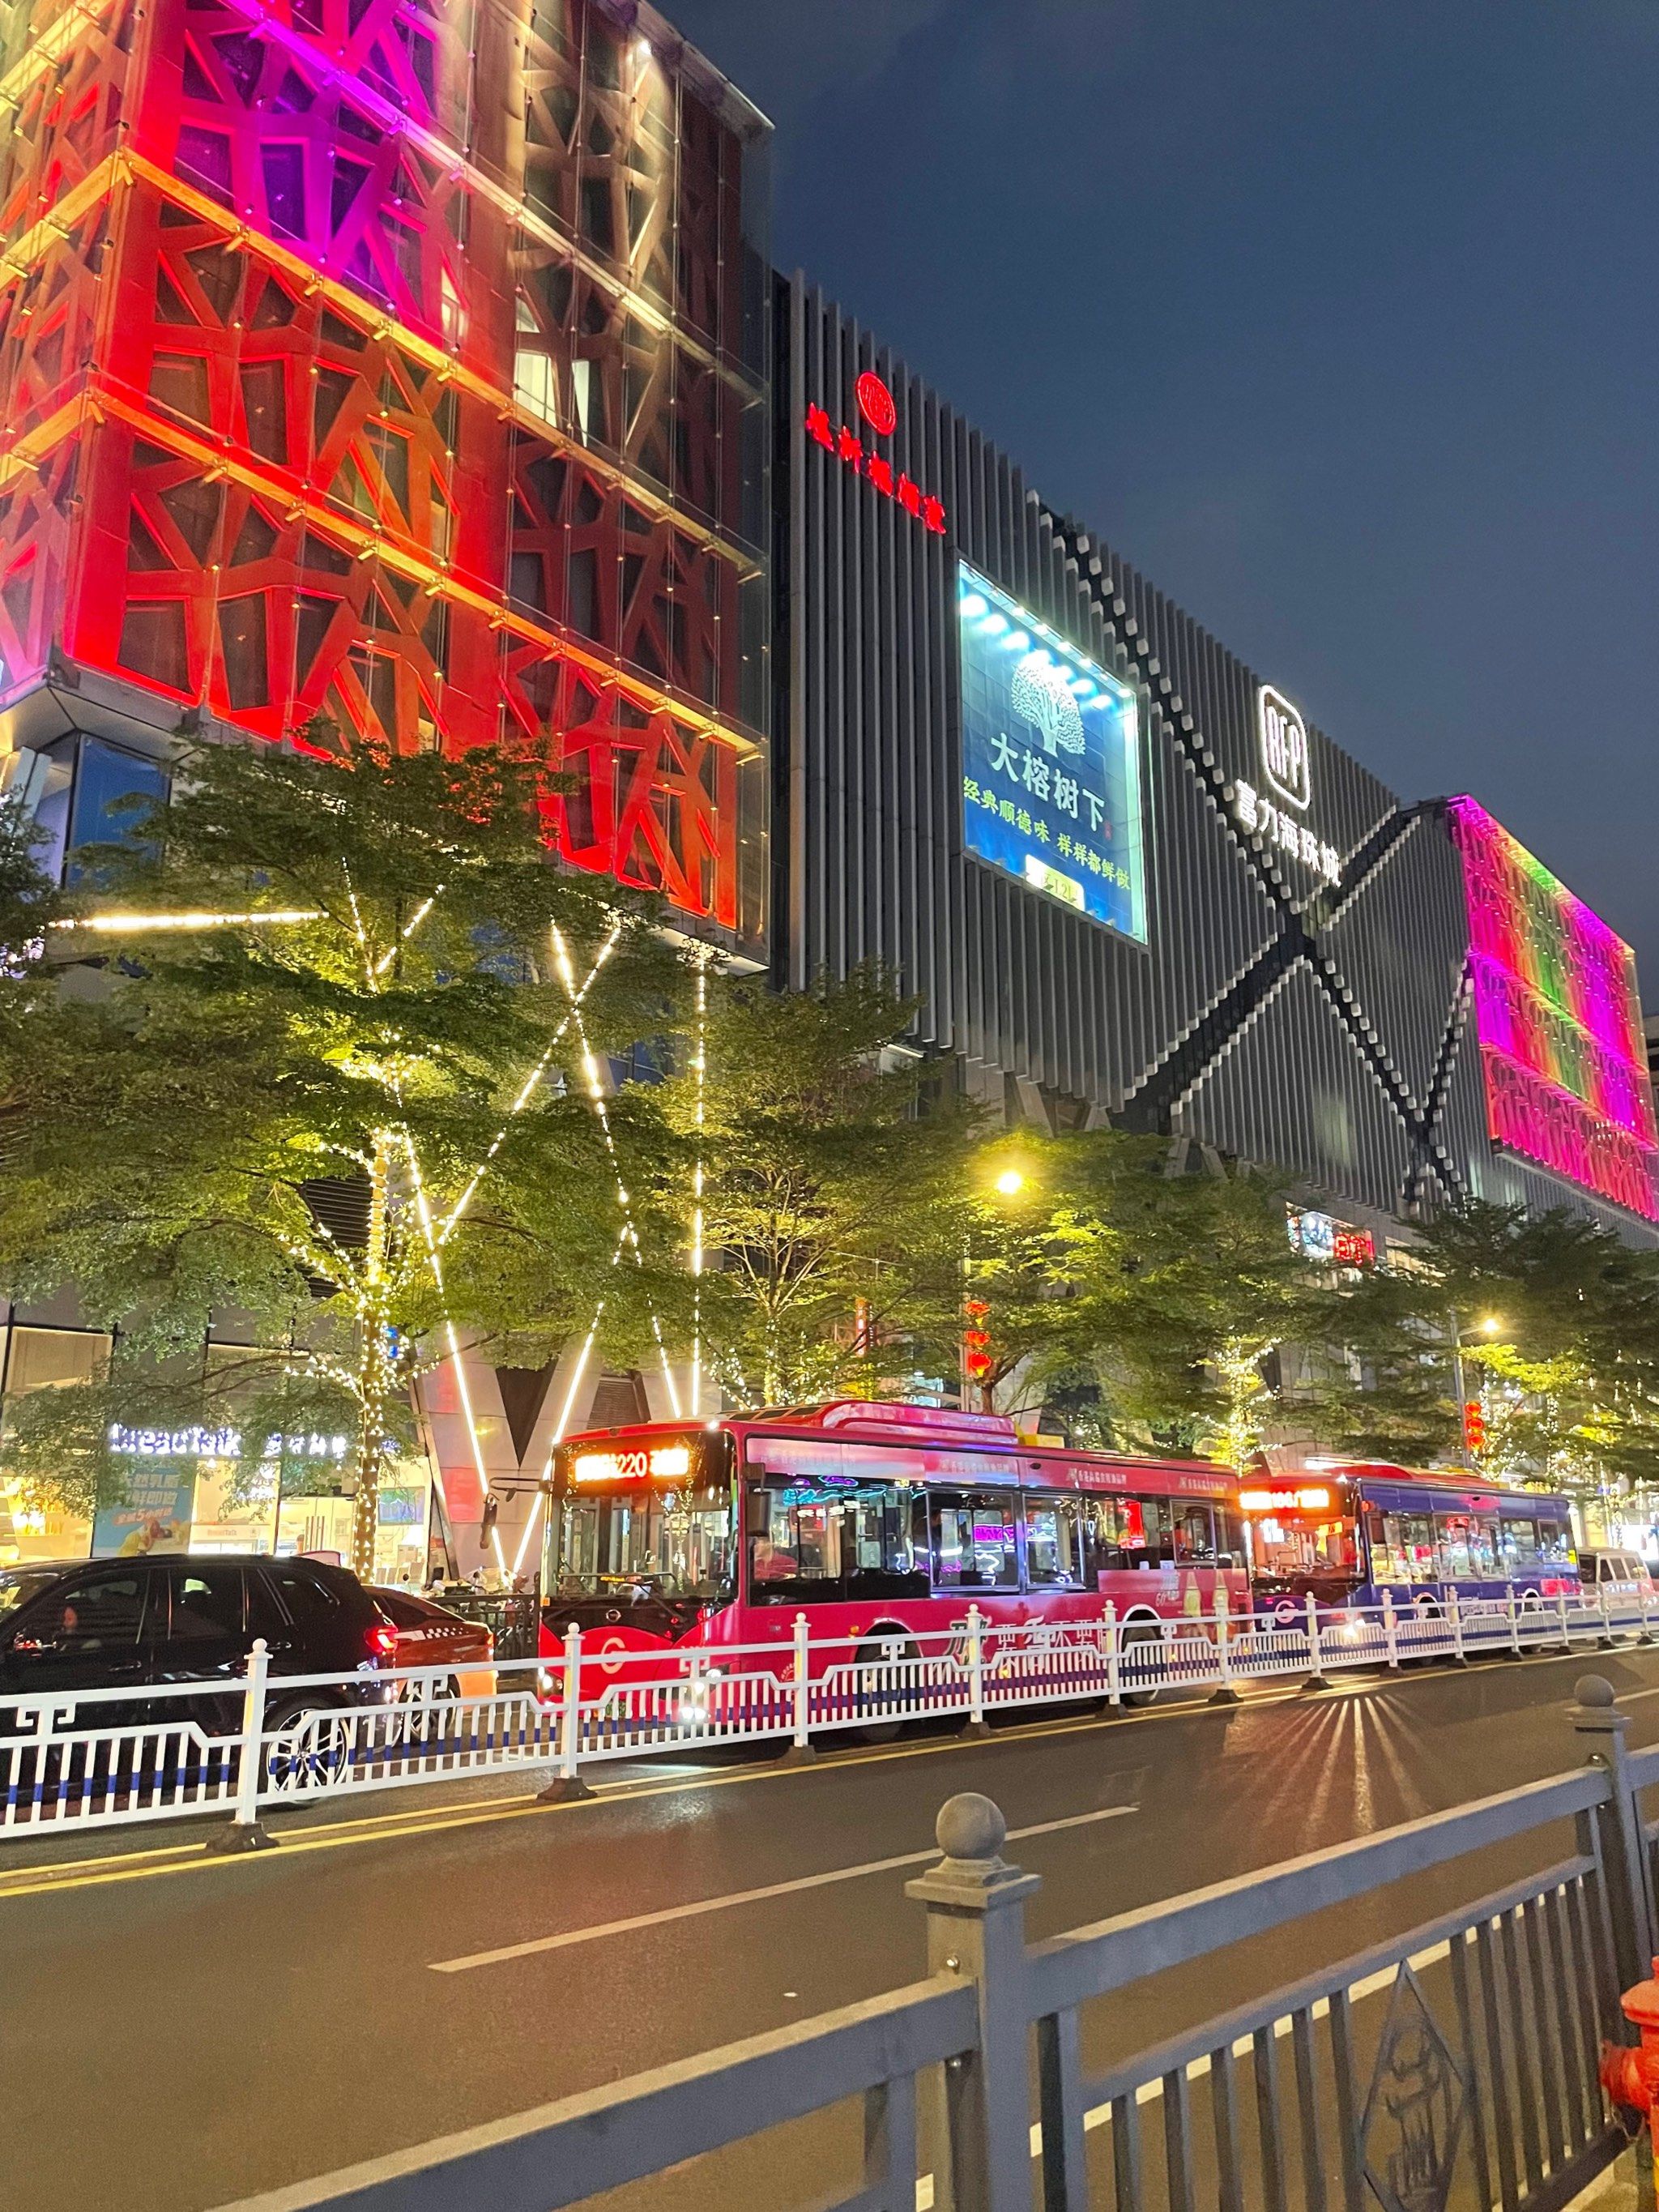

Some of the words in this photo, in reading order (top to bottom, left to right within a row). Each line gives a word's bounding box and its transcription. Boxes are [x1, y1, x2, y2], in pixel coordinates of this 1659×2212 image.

[963, 775, 1051, 843] 经典顺德味
[990, 732, 1107, 832] 大榕树下
